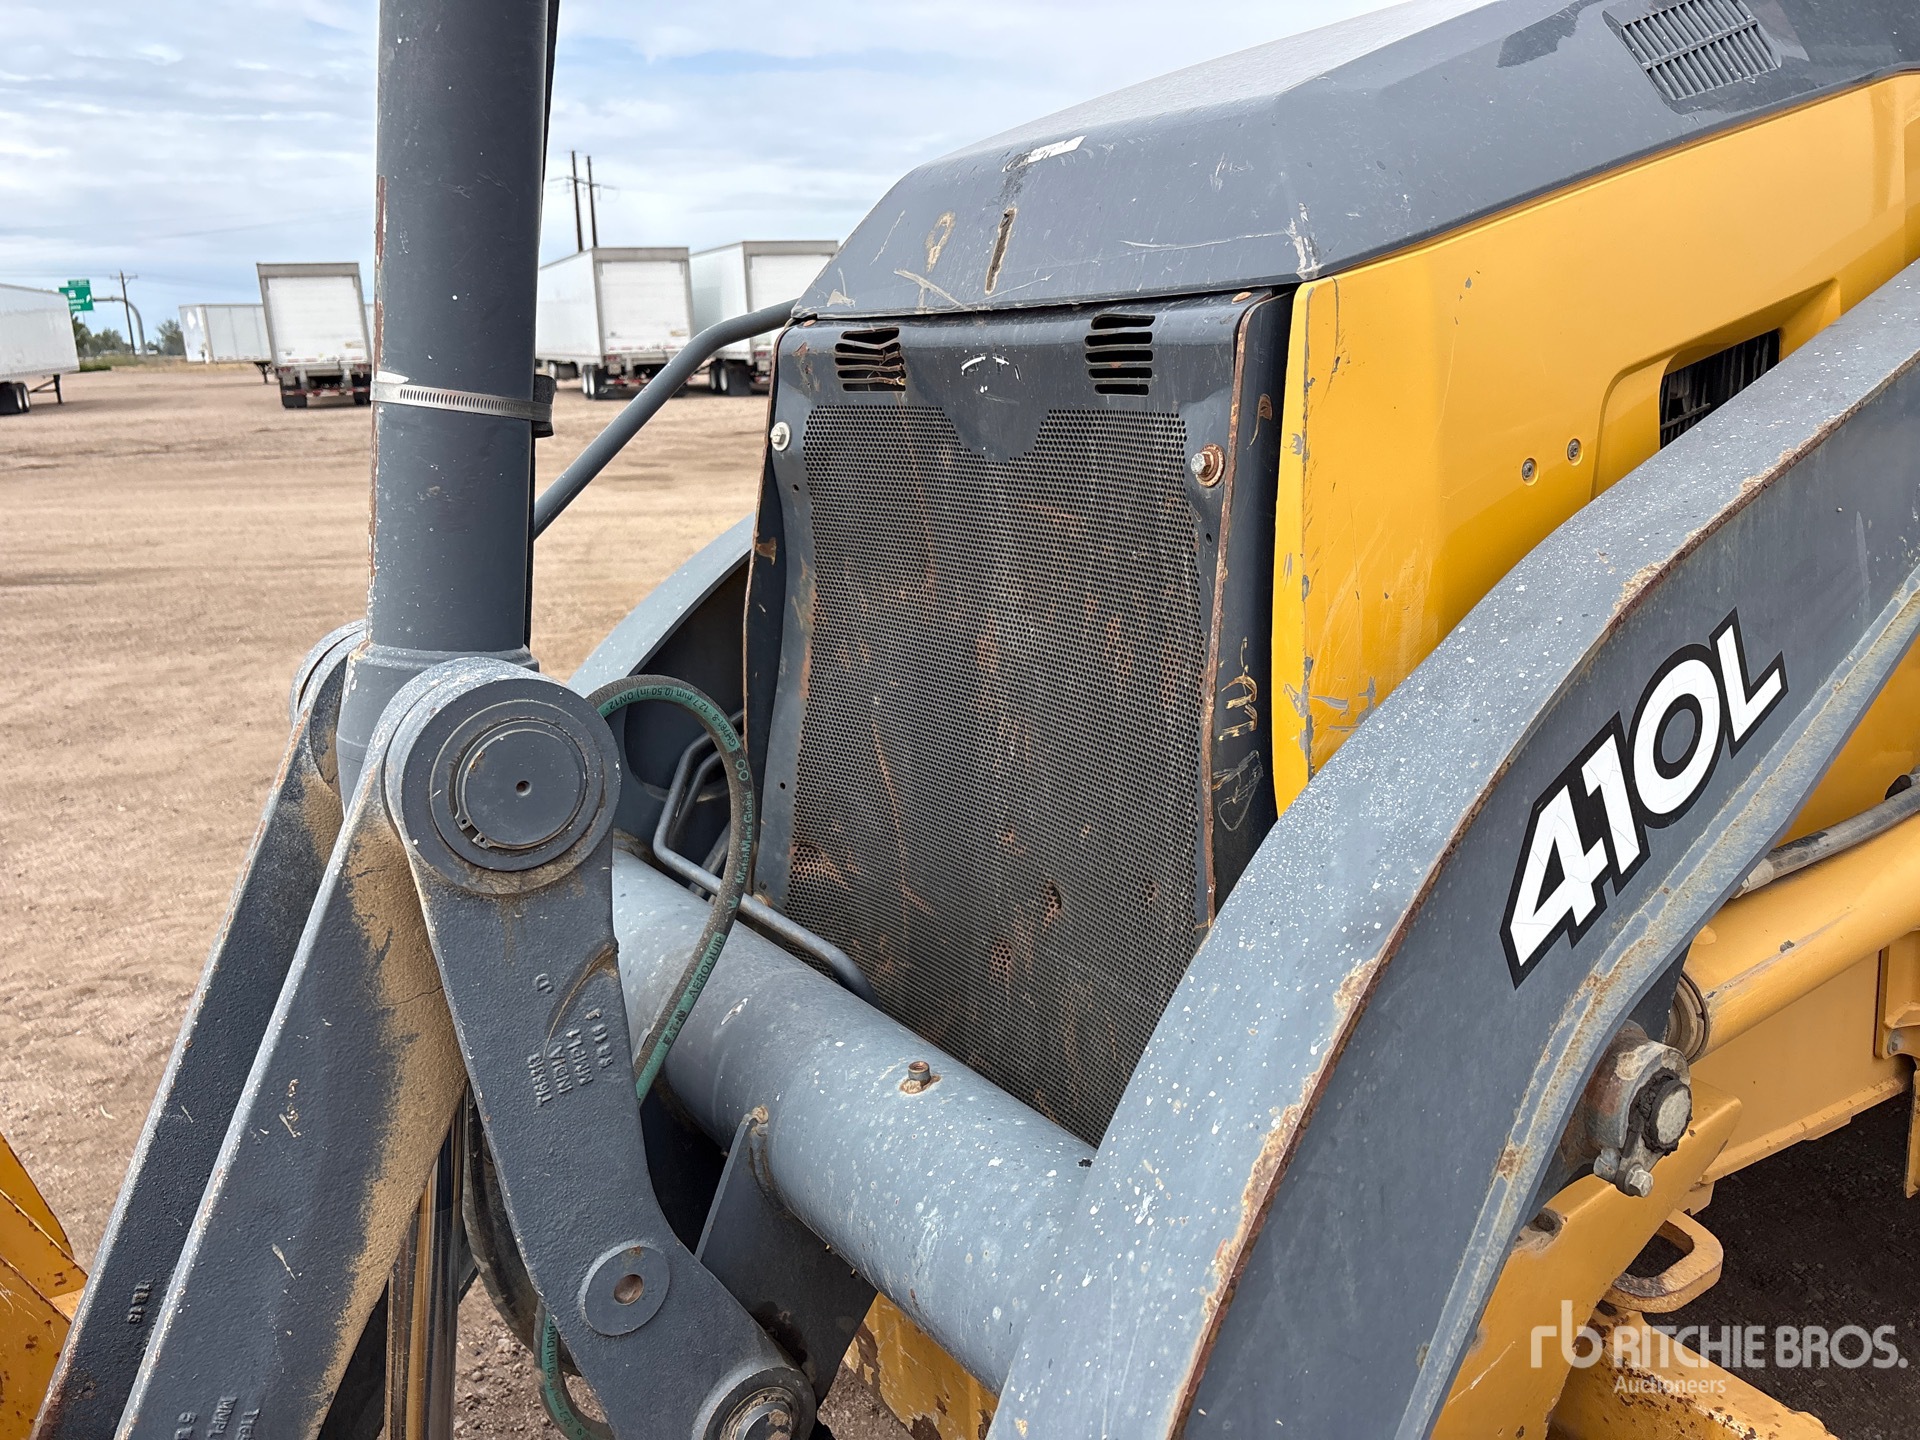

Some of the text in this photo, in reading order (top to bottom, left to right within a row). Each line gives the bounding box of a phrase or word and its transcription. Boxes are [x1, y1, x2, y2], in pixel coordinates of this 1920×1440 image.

[675, 689, 693, 702] mm
[1500, 607, 1789, 990] 410L
[688, 935, 725, 999] AEROQUIP
[549, 1045, 573, 1095] INDIA
